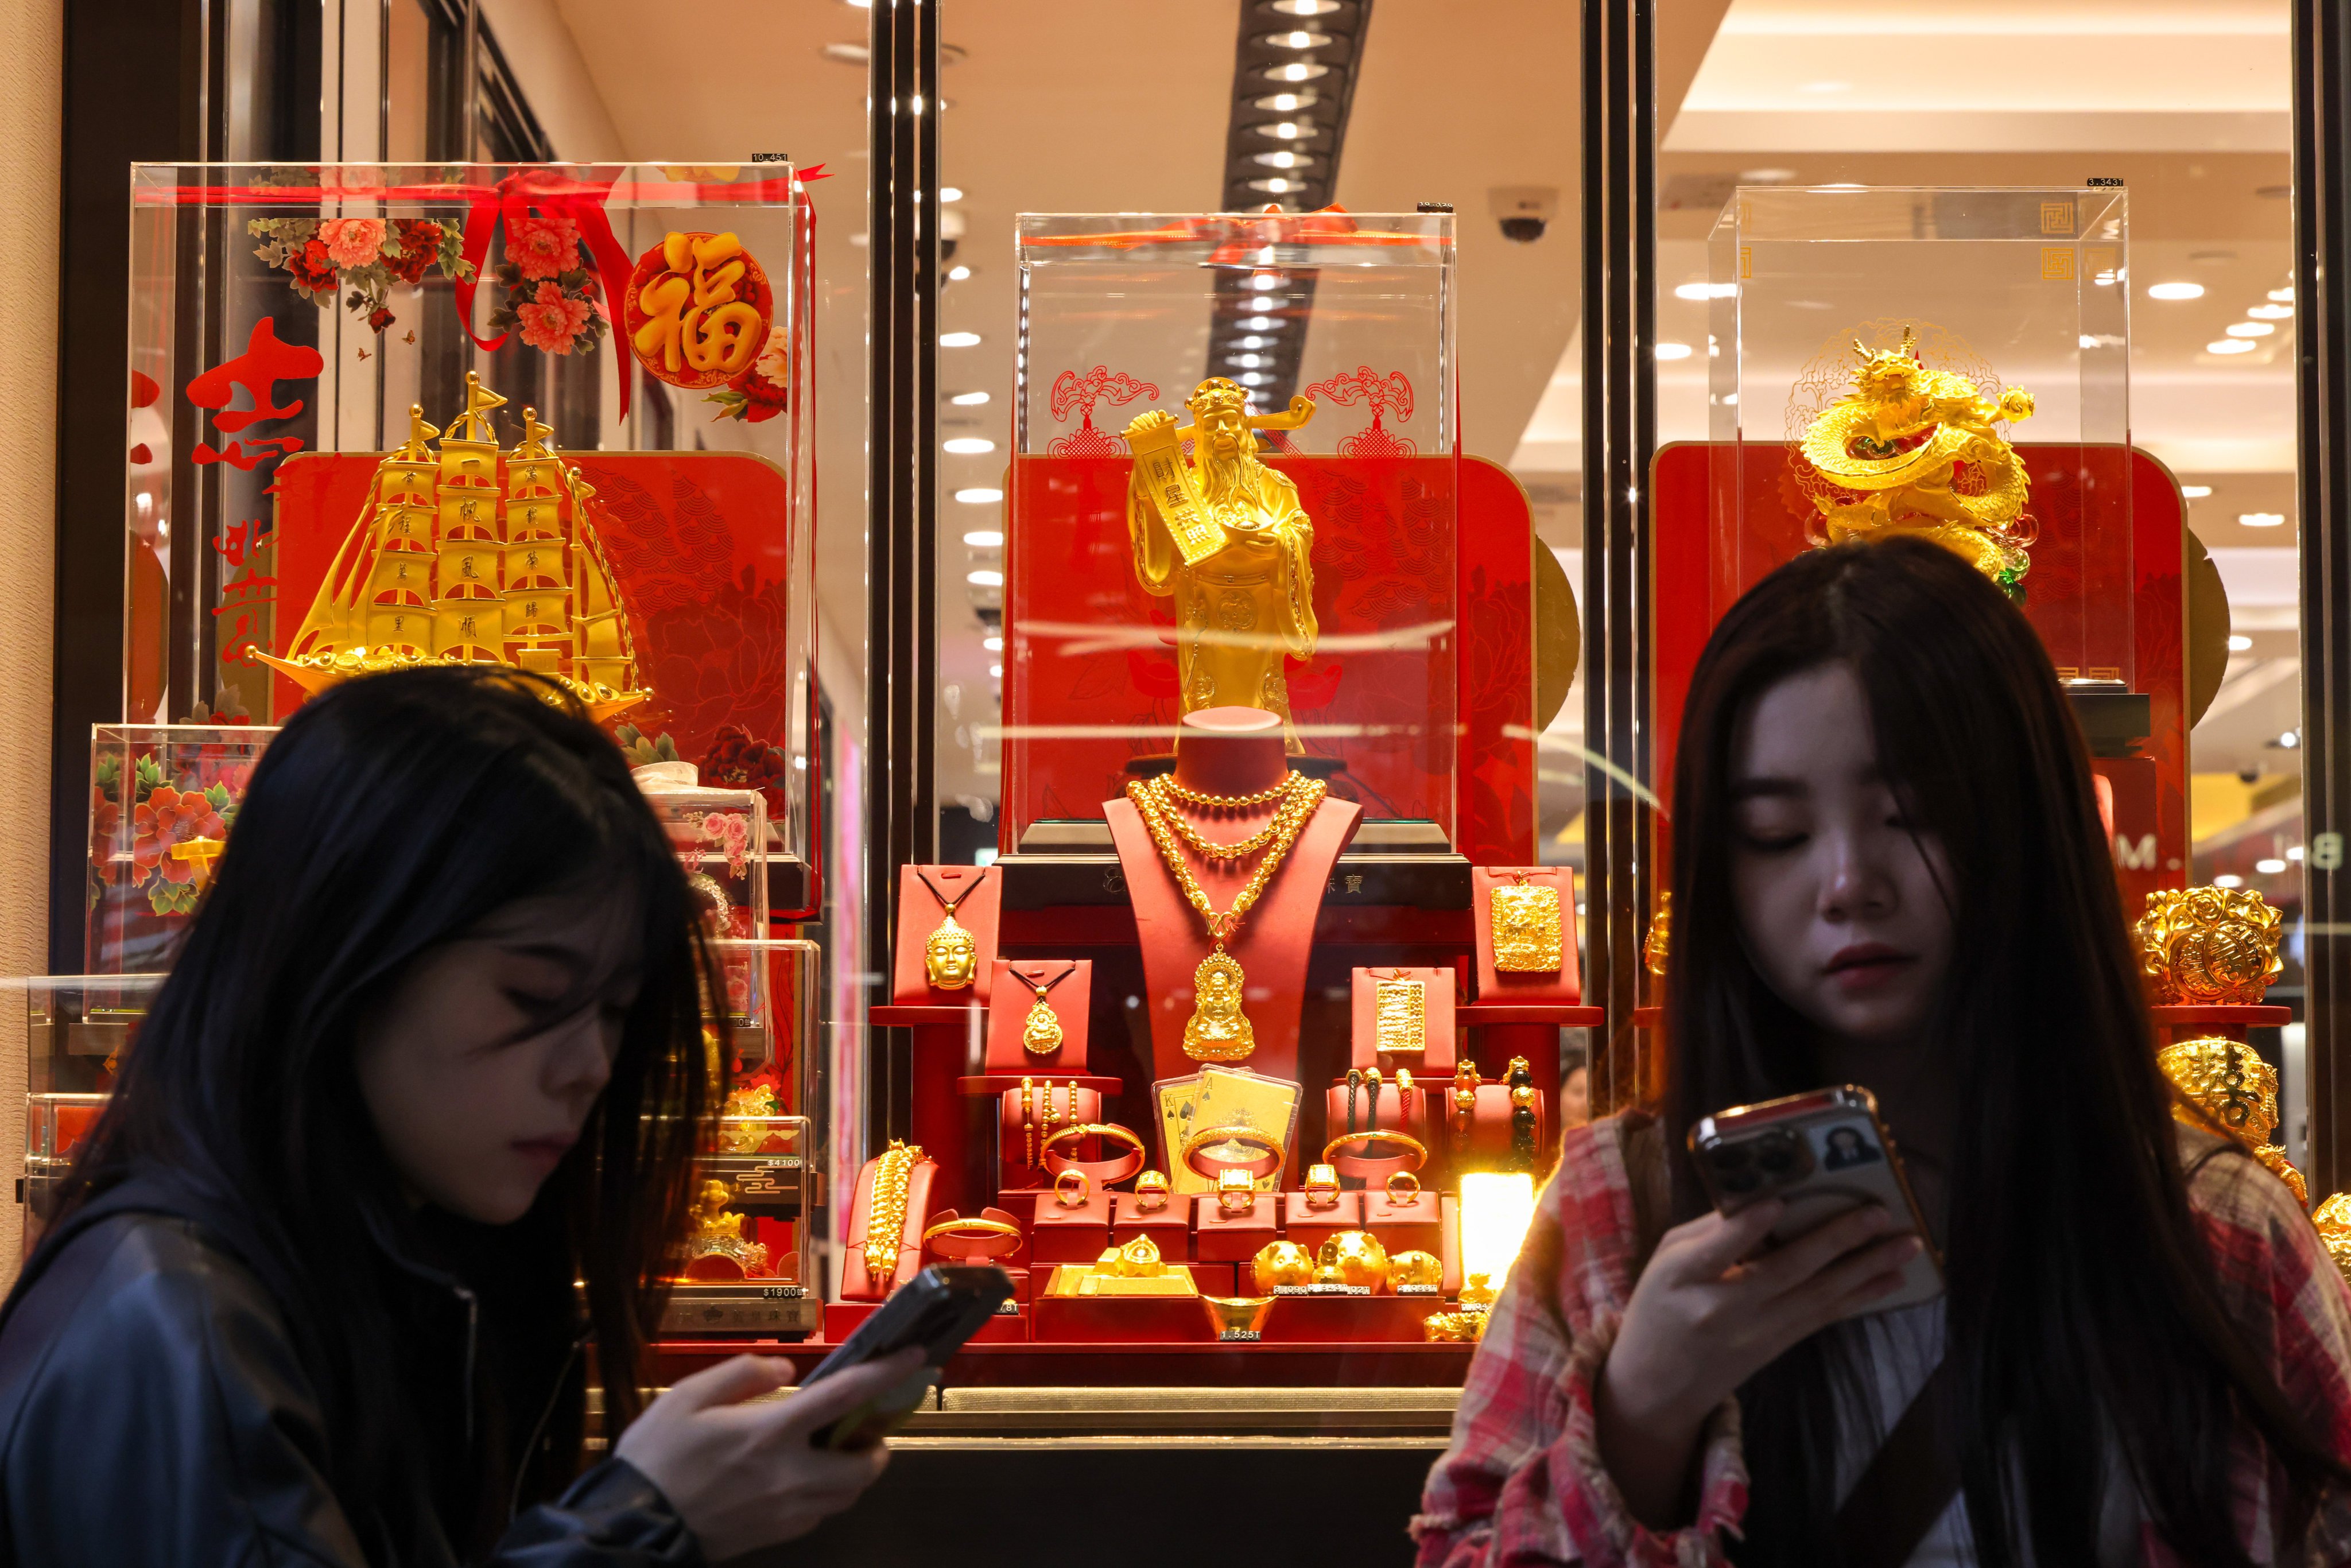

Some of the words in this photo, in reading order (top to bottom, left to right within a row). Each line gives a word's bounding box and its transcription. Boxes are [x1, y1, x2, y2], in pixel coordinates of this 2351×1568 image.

[634, 231, 762, 373] 福
[1153, 456, 1212, 547] 財星拱照
[457, 458, 482, 639] 一帆風順
[1163, 1093, 1174, 1108] K
[1204, 1078, 1213, 1090] A
